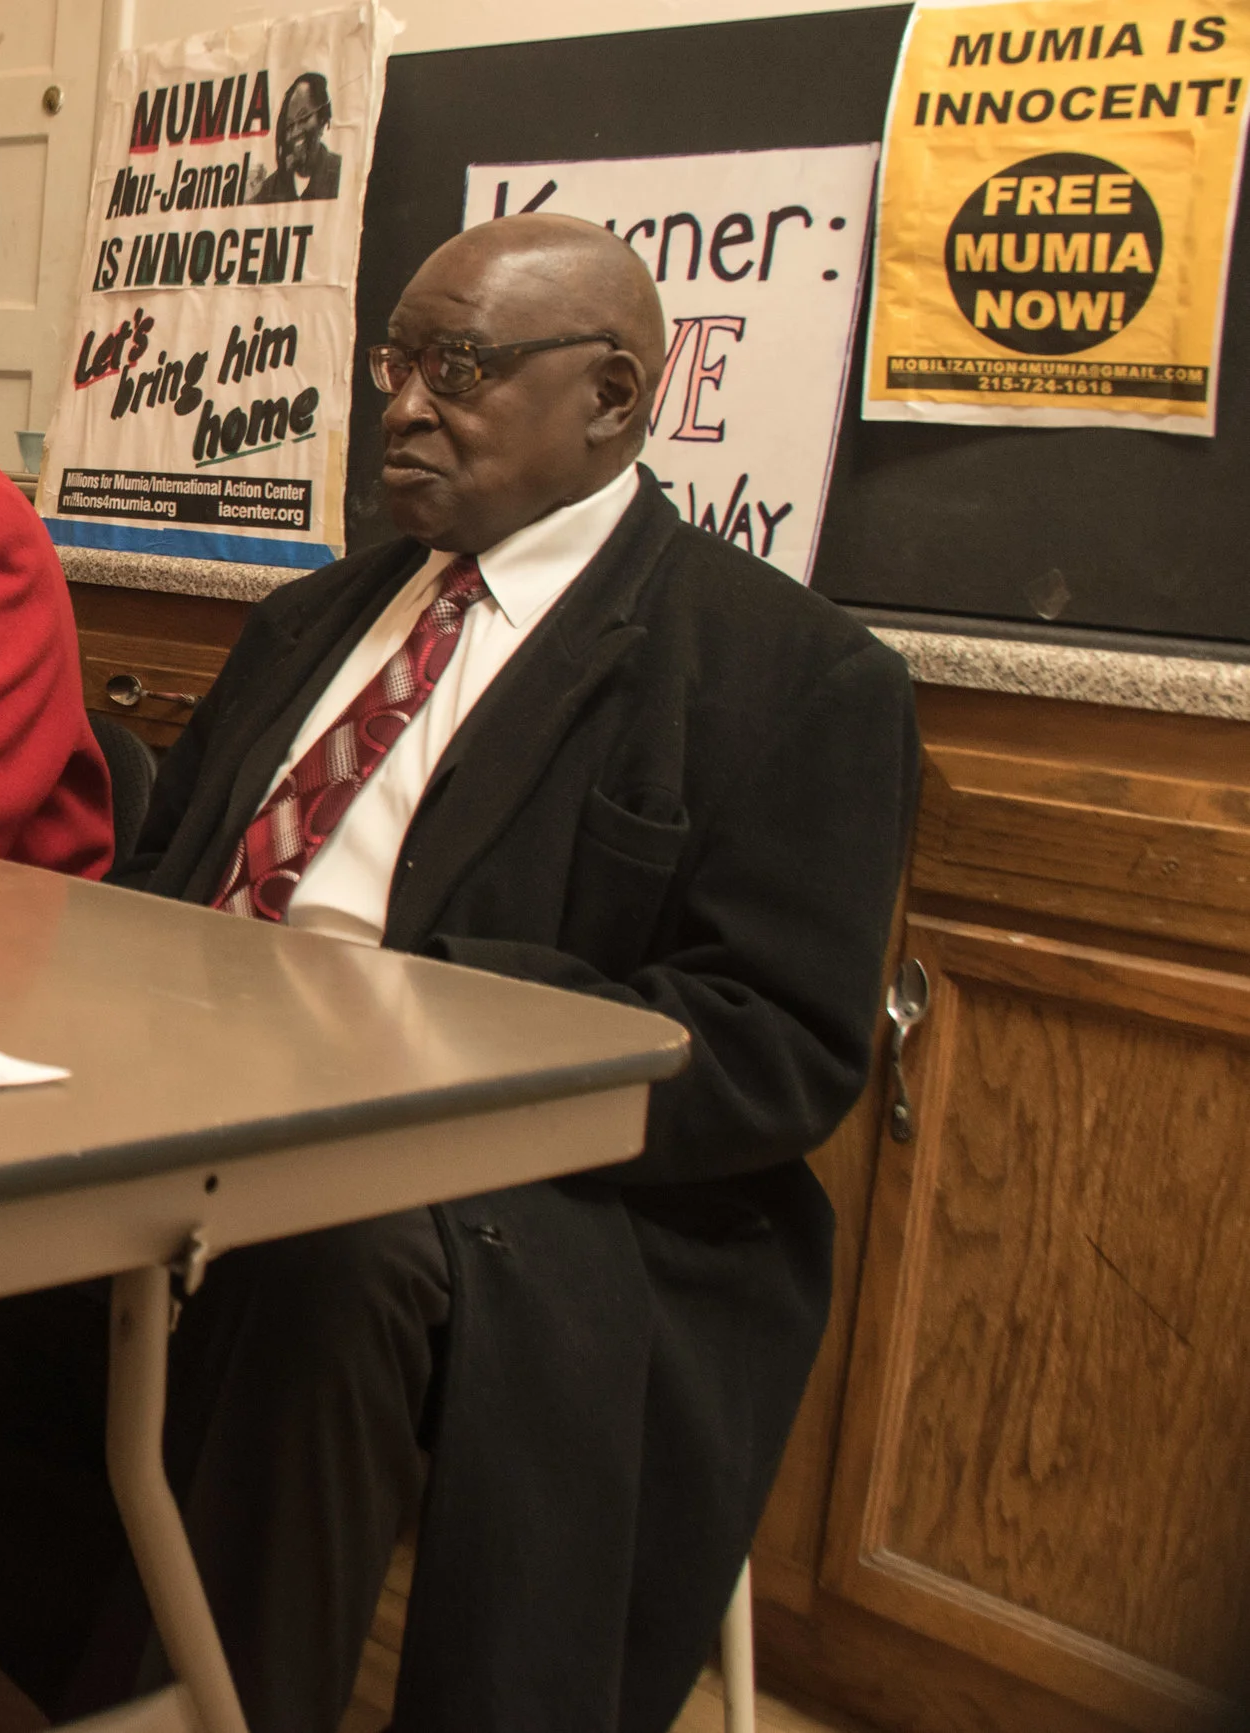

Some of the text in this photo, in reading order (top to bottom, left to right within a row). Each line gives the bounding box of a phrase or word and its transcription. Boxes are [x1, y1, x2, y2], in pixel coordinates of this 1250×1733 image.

[949, 16, 1228, 67] MUMIA IS
[129, 70, 270, 150] MUMIA
[913, 78, 1242, 126] INNOCENT!
[105, 152, 251, 220] Abu-Jamal
[983, 174, 1134, 216] FREE
[92, 225, 314, 292] IS INNOCENT
[954, 232, 1154, 273] MUMIA
[974, 290, 1126, 331] NOW!
[75, 308, 154, 386] Let's
[111, 316, 297, 420] bring him
[192, 387, 319, 461] home
[62, 492, 304, 525] millions4mumia.org iacenter.org
[65, 472, 306, 501] Millions for Mumia/International Action Center
